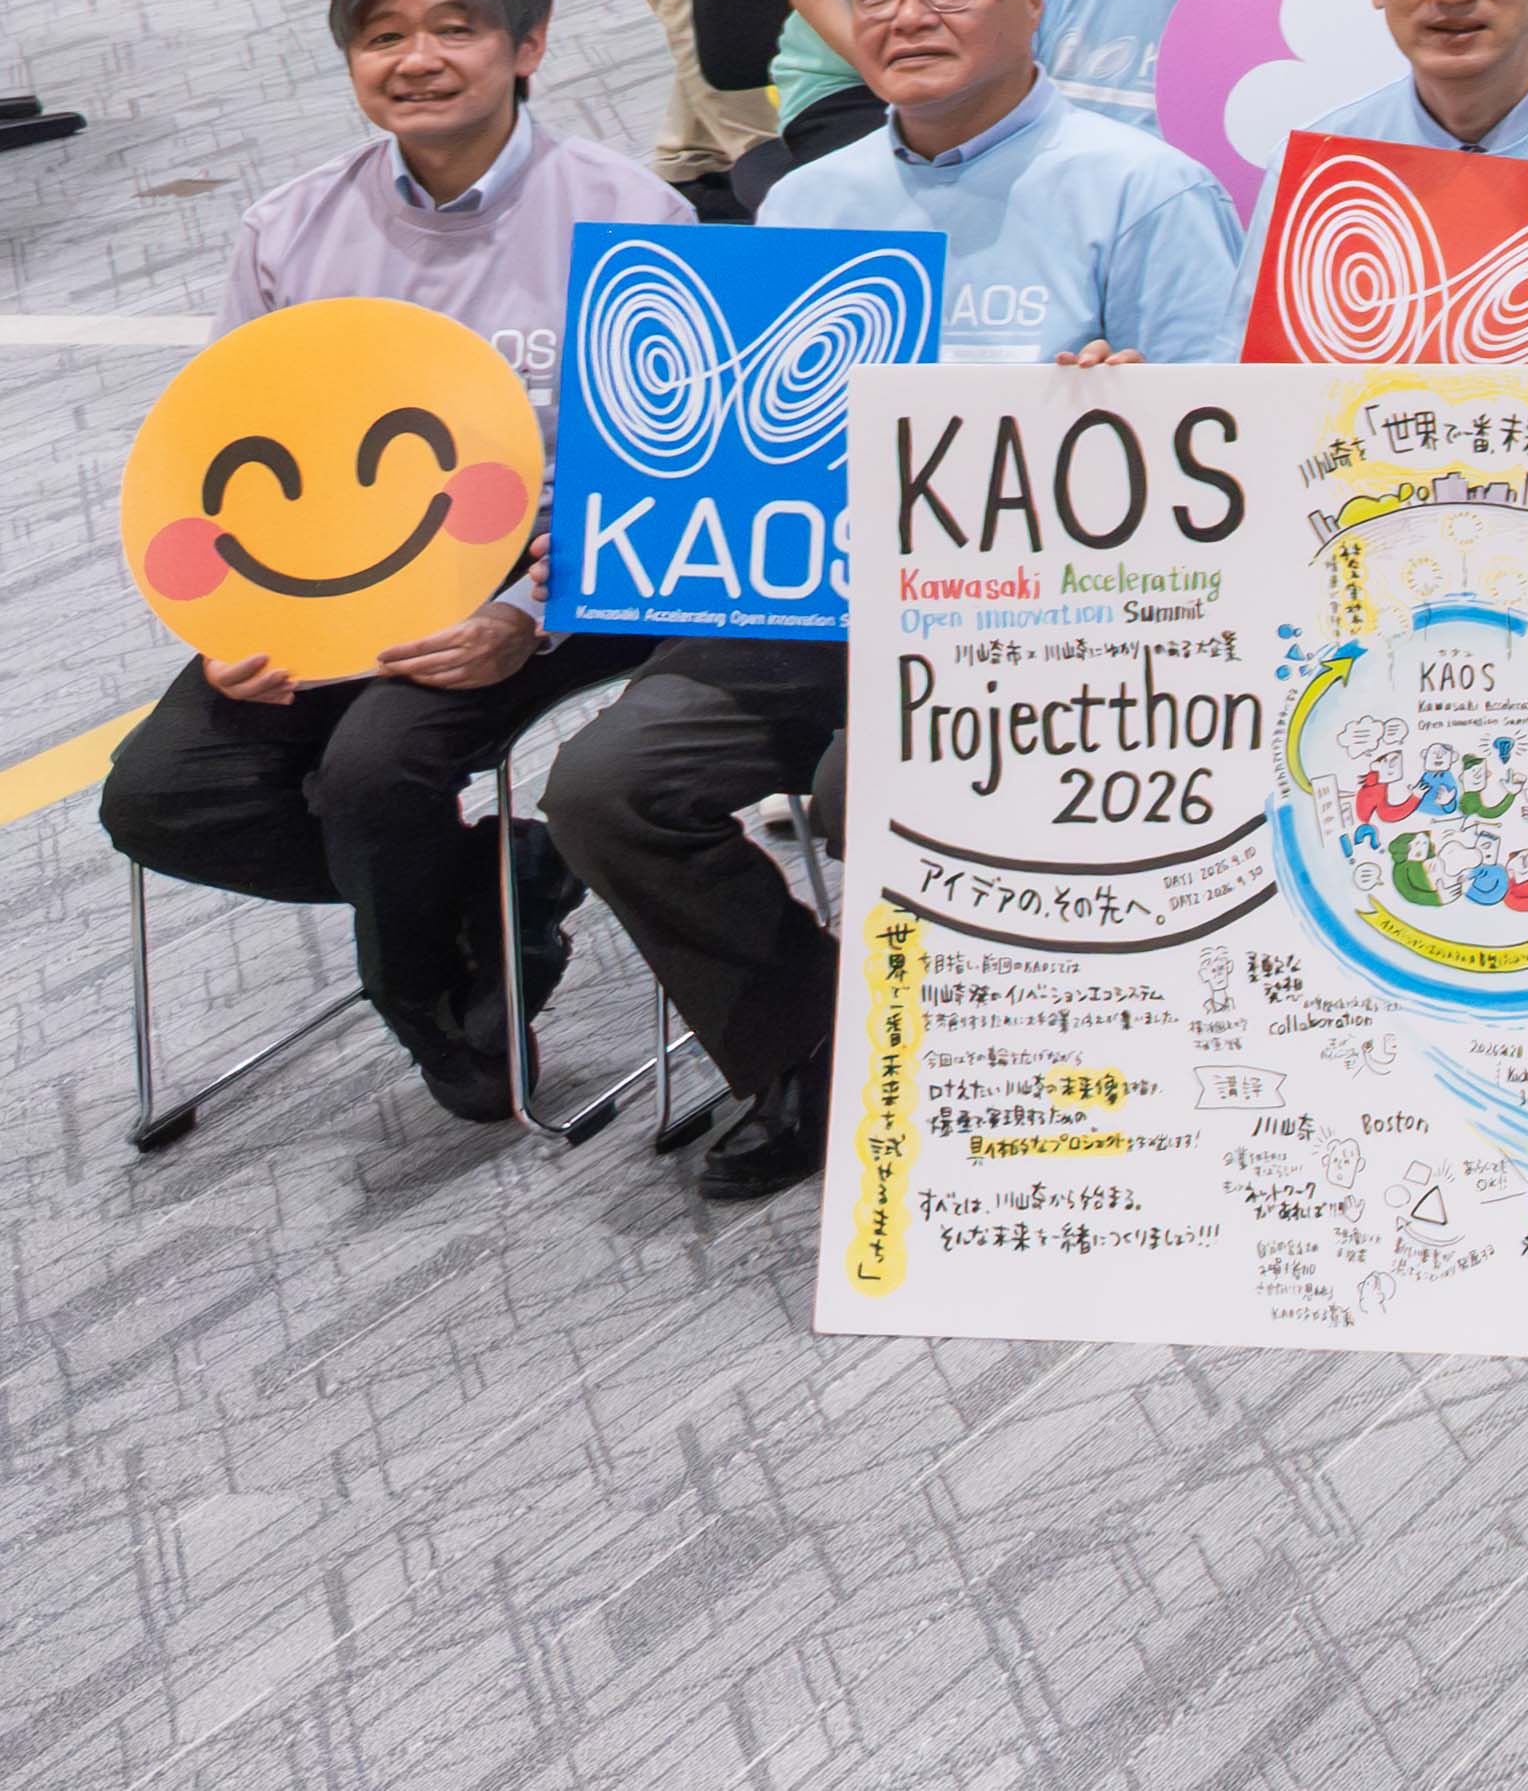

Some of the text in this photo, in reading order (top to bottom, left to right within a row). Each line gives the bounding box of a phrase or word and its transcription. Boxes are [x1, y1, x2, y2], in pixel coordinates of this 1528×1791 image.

[946, 285, 1050, 327] AOS
[897, 406, 1246, 555] KAOS
[900, 562, 1223, 603] Kawasaki Accelerating
[901, 599, 1207, 640] Open Summit
[1420, 662, 1496, 693] KAOS
[898, 644, 1263, 797] Projectthon
[1052, 767, 1216, 826] 2026
[1360, 1112, 1429, 1136] Boston
